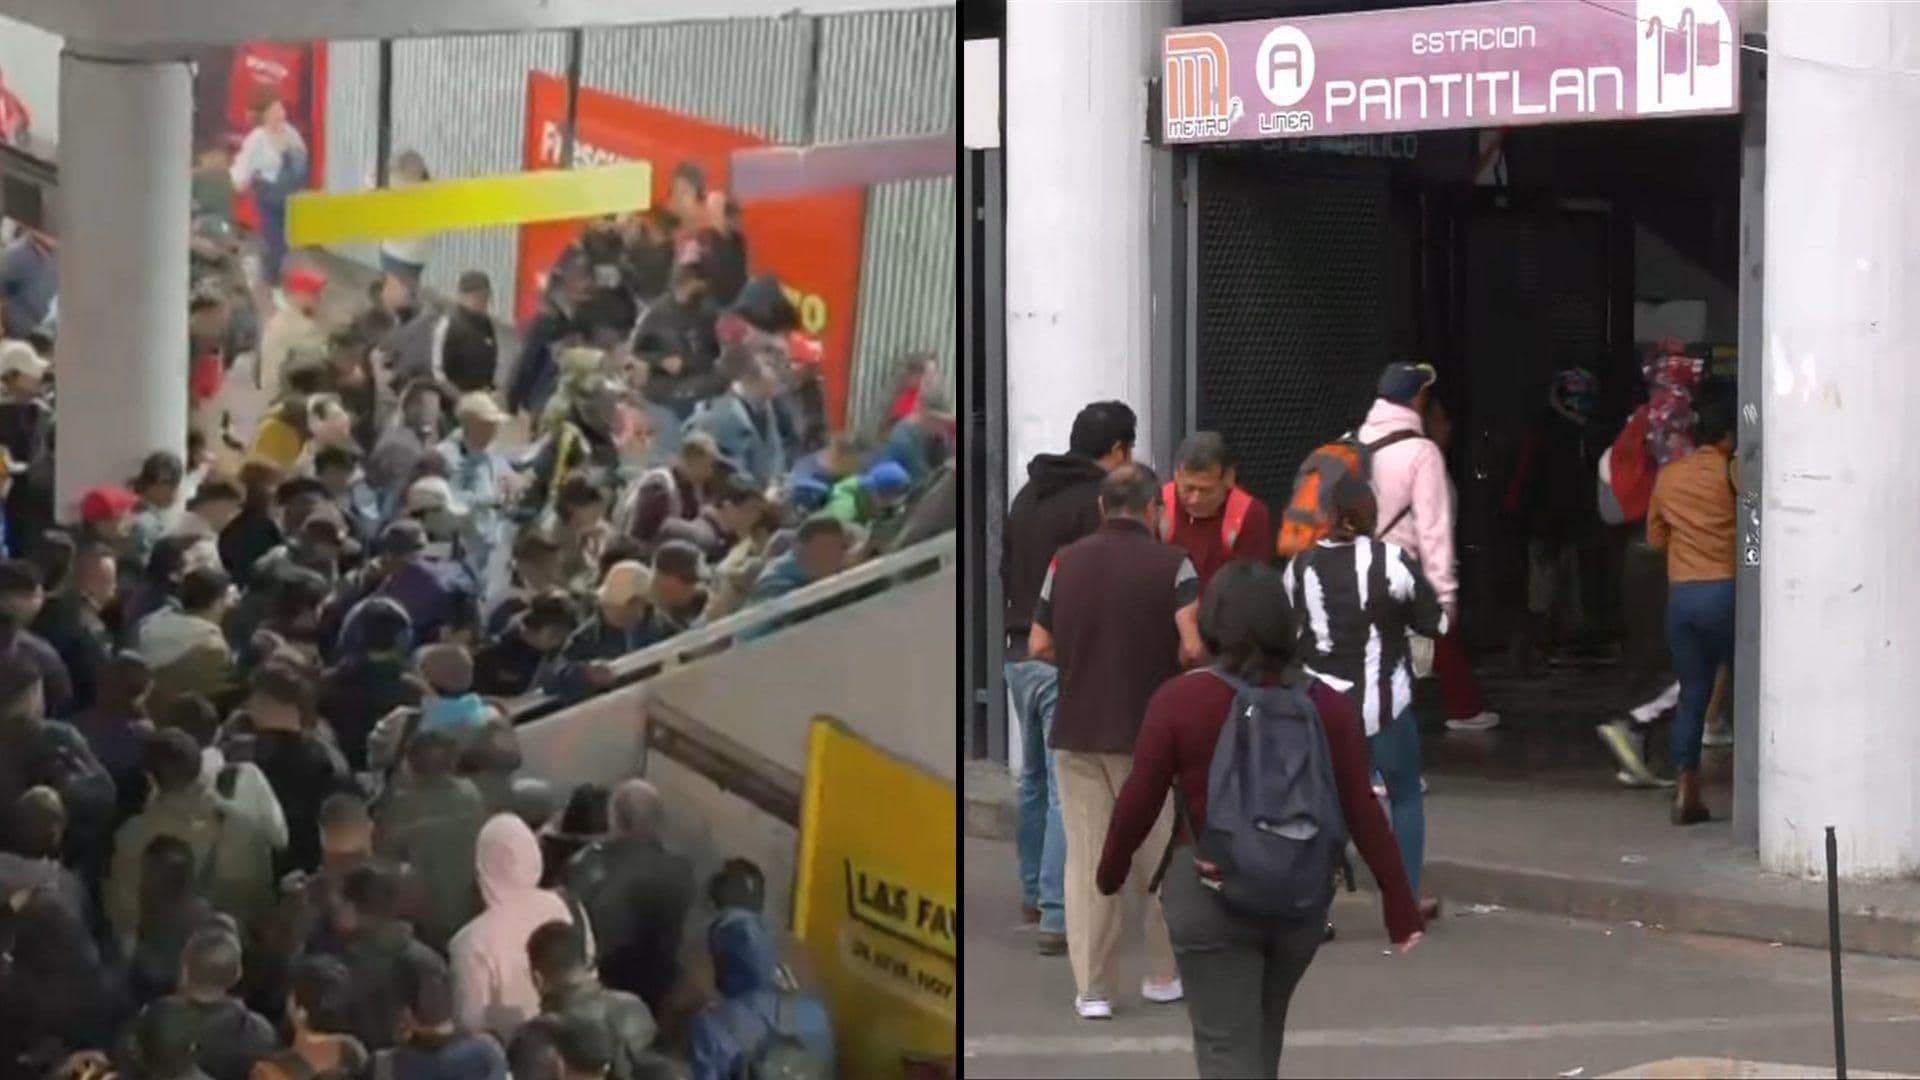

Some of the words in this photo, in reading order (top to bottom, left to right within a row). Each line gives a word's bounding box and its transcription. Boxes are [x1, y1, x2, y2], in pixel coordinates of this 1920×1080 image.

[1412, 25, 1536, 54] ESTACION
[1268, 43, 1302, 90] A
[1325, 66, 1624, 124] PANTITLAN
[1167, 119, 1230, 138] METRO
[1259, 111, 1314, 134] LINEA
[858, 872, 908, 923] LAS
